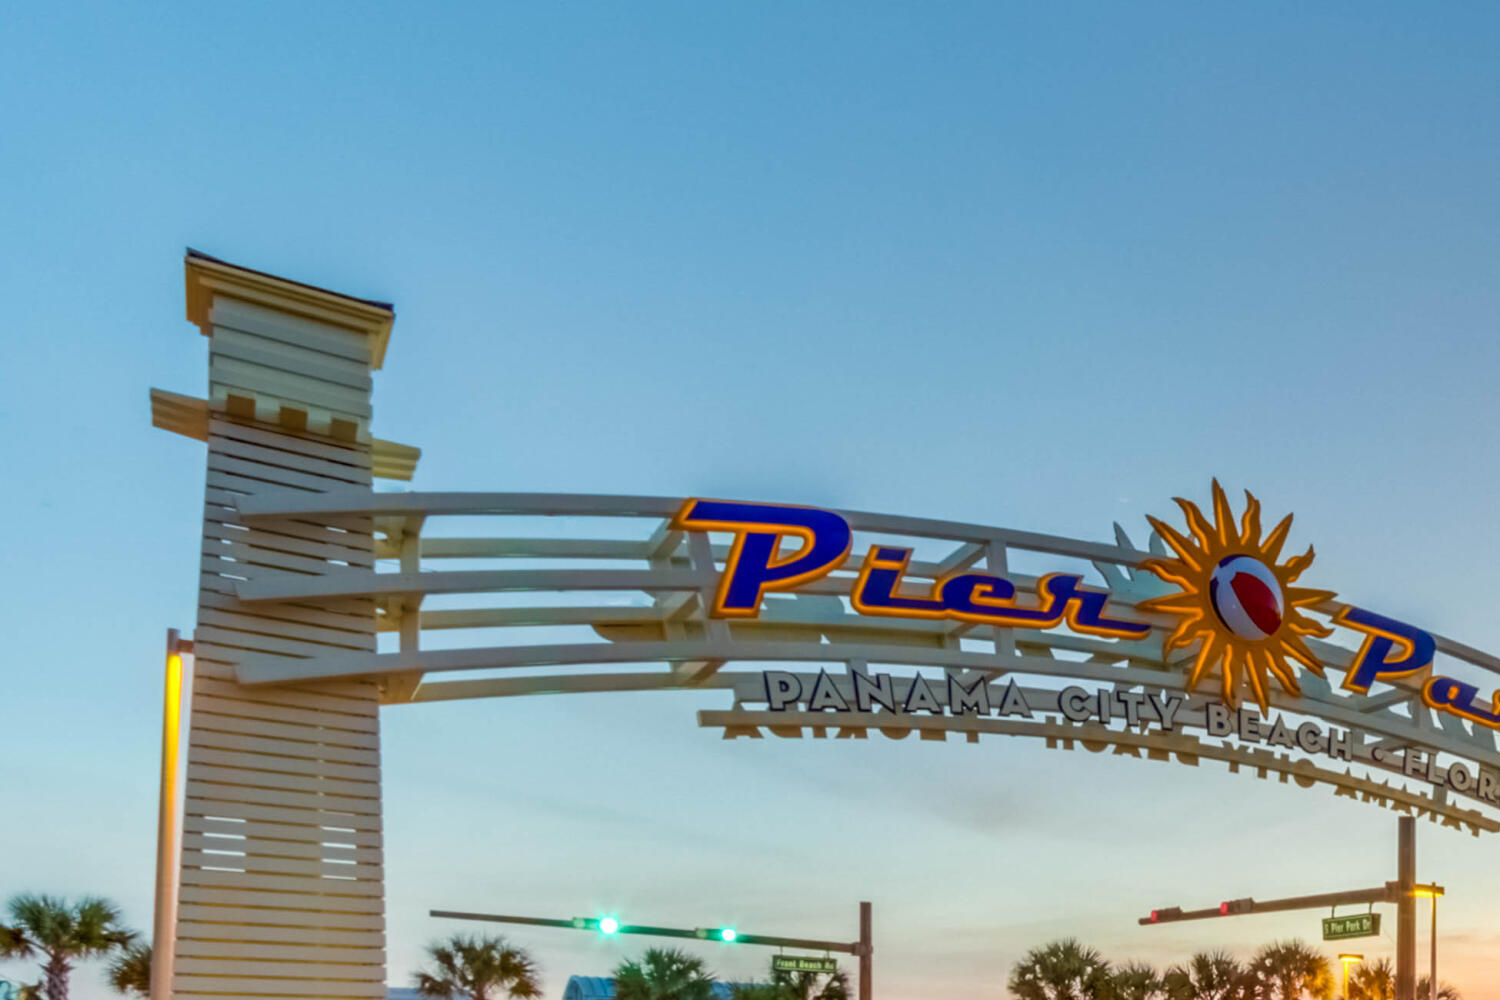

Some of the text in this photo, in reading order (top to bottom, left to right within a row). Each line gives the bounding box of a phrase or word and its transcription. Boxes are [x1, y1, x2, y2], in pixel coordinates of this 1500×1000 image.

[669, 497, 1151, 640] Pier
[763, 666, 1034, 719] PANAMA
[1057, 685, 1183, 731] CITY
[1206, 702, 1353, 762] BEACH
[1330, 922, 1344, 934] Pier
[1345, 919, 1361, 932] Park
